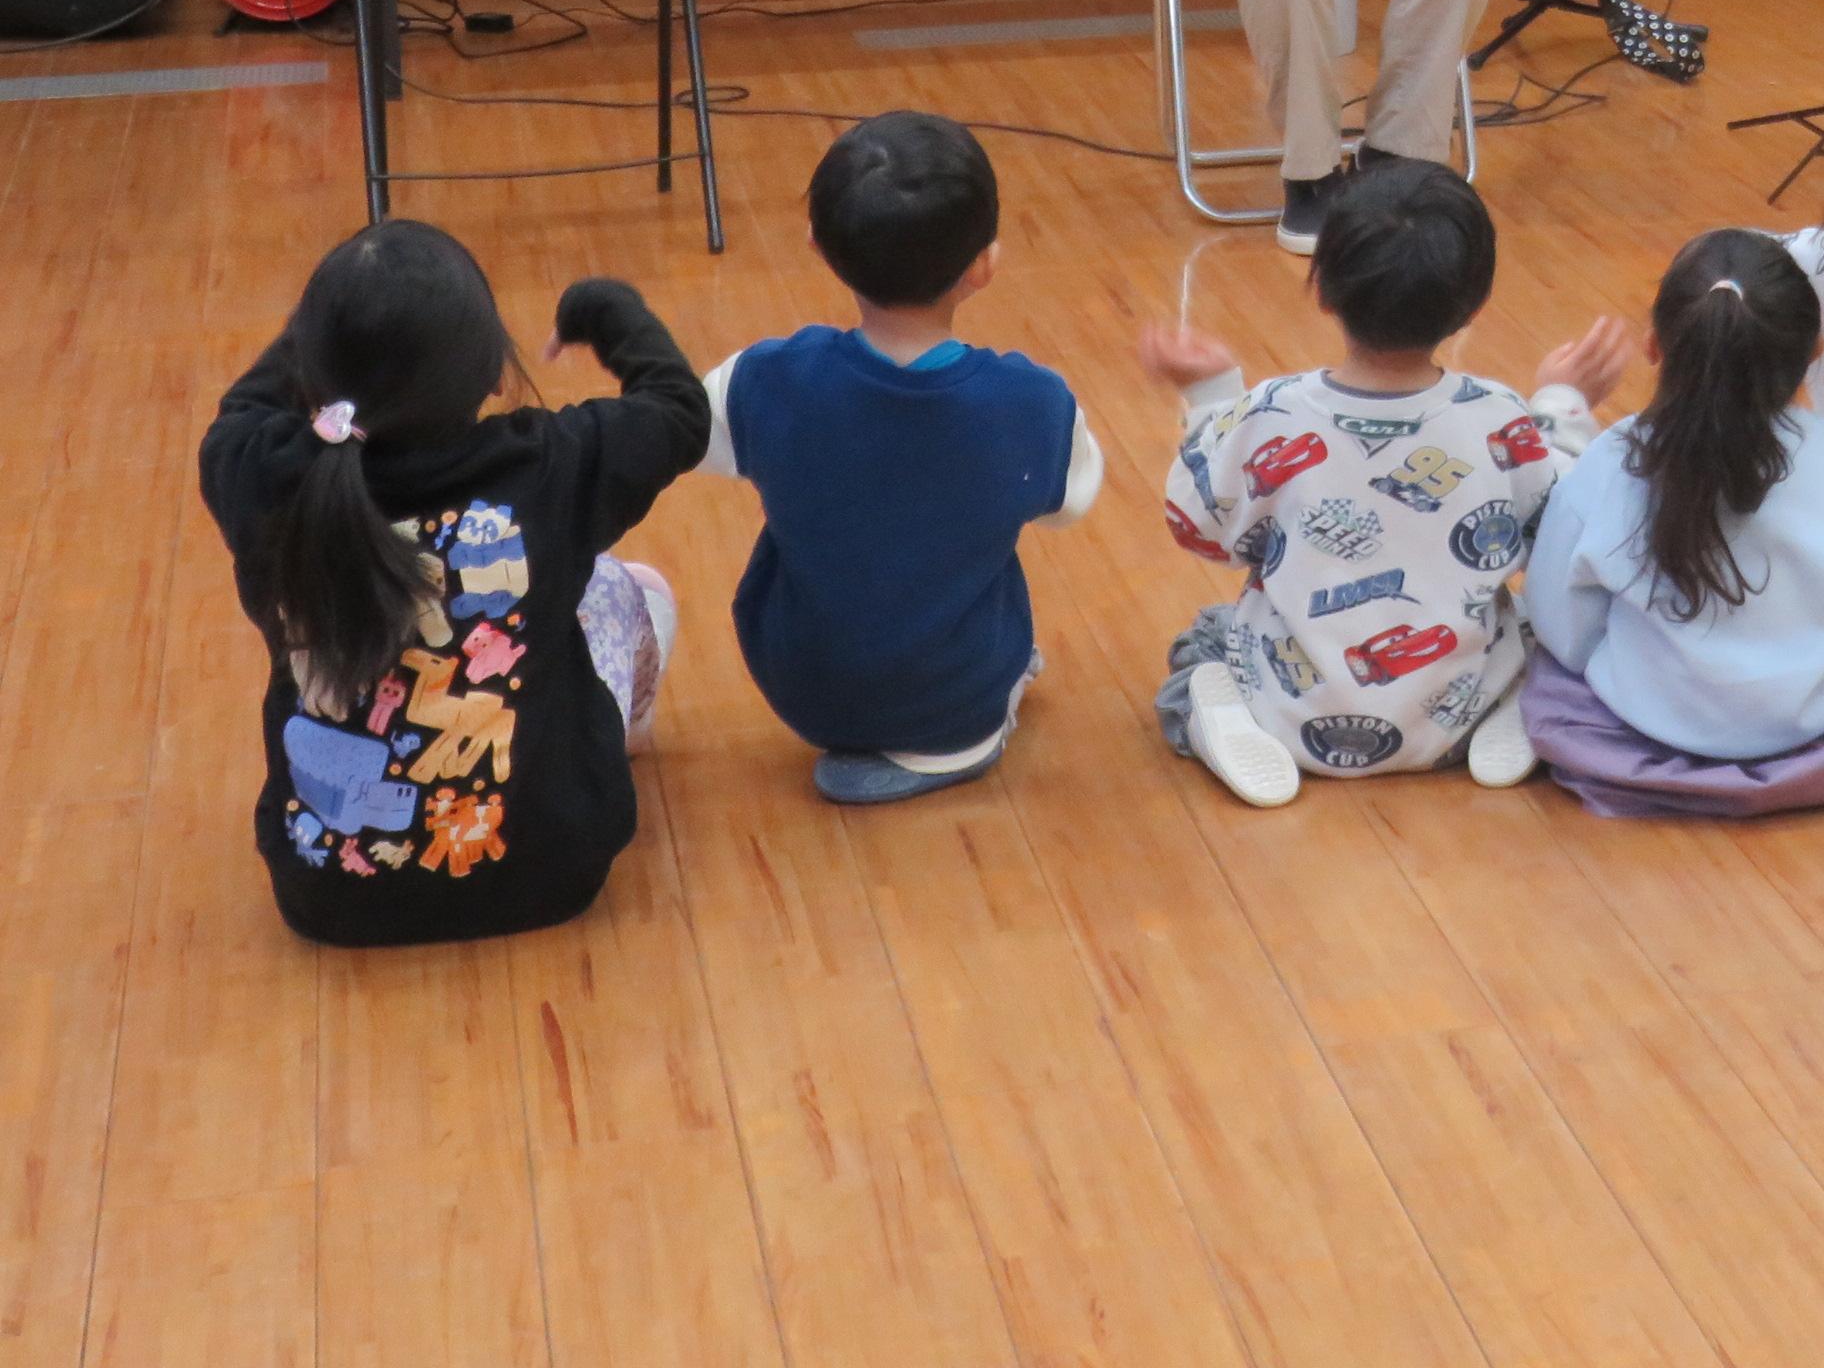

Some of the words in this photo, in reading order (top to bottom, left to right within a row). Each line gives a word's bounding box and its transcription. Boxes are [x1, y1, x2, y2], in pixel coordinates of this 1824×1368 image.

[1338, 418, 1410, 435] Cars
[1389, 446, 1475, 499] 95
[1462, 501, 1512, 530] PISTO
[1479, 550, 1509, 569] CUP
[1311, 717, 1393, 735] PISTON
[1326, 751, 1368, 766] CUP
